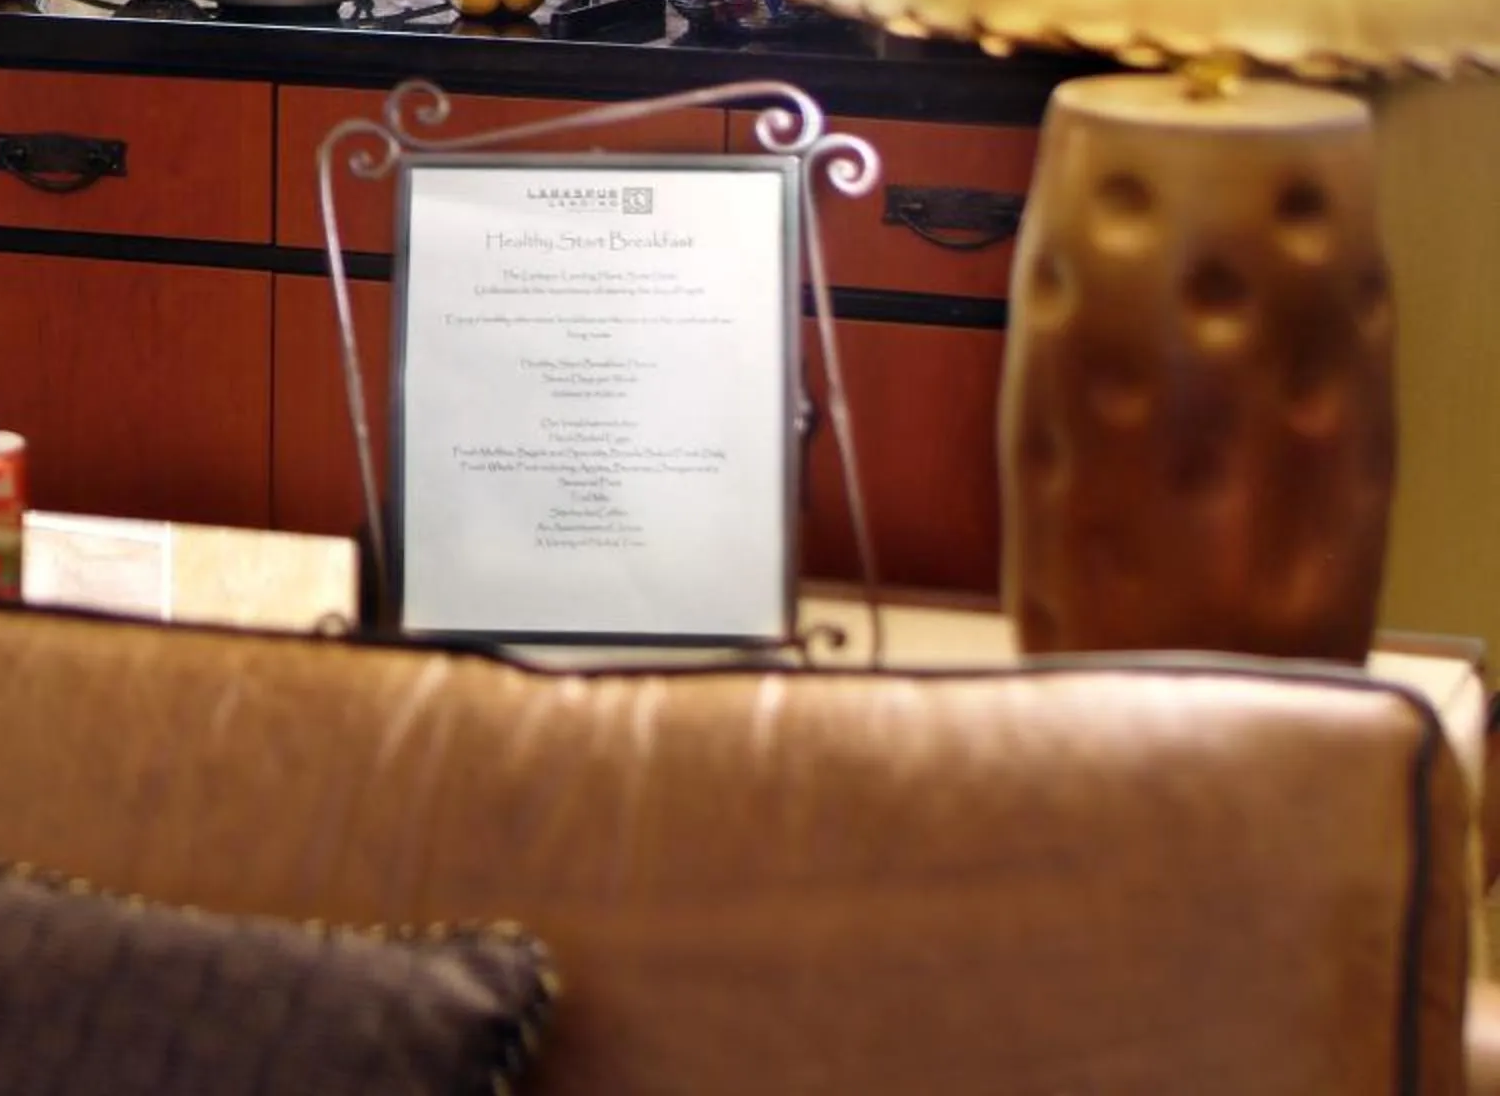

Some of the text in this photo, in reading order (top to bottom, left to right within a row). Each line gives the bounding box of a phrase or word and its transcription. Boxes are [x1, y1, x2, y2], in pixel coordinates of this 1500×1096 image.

[485, 229, 695, 254] Healthy Start Breakfast
